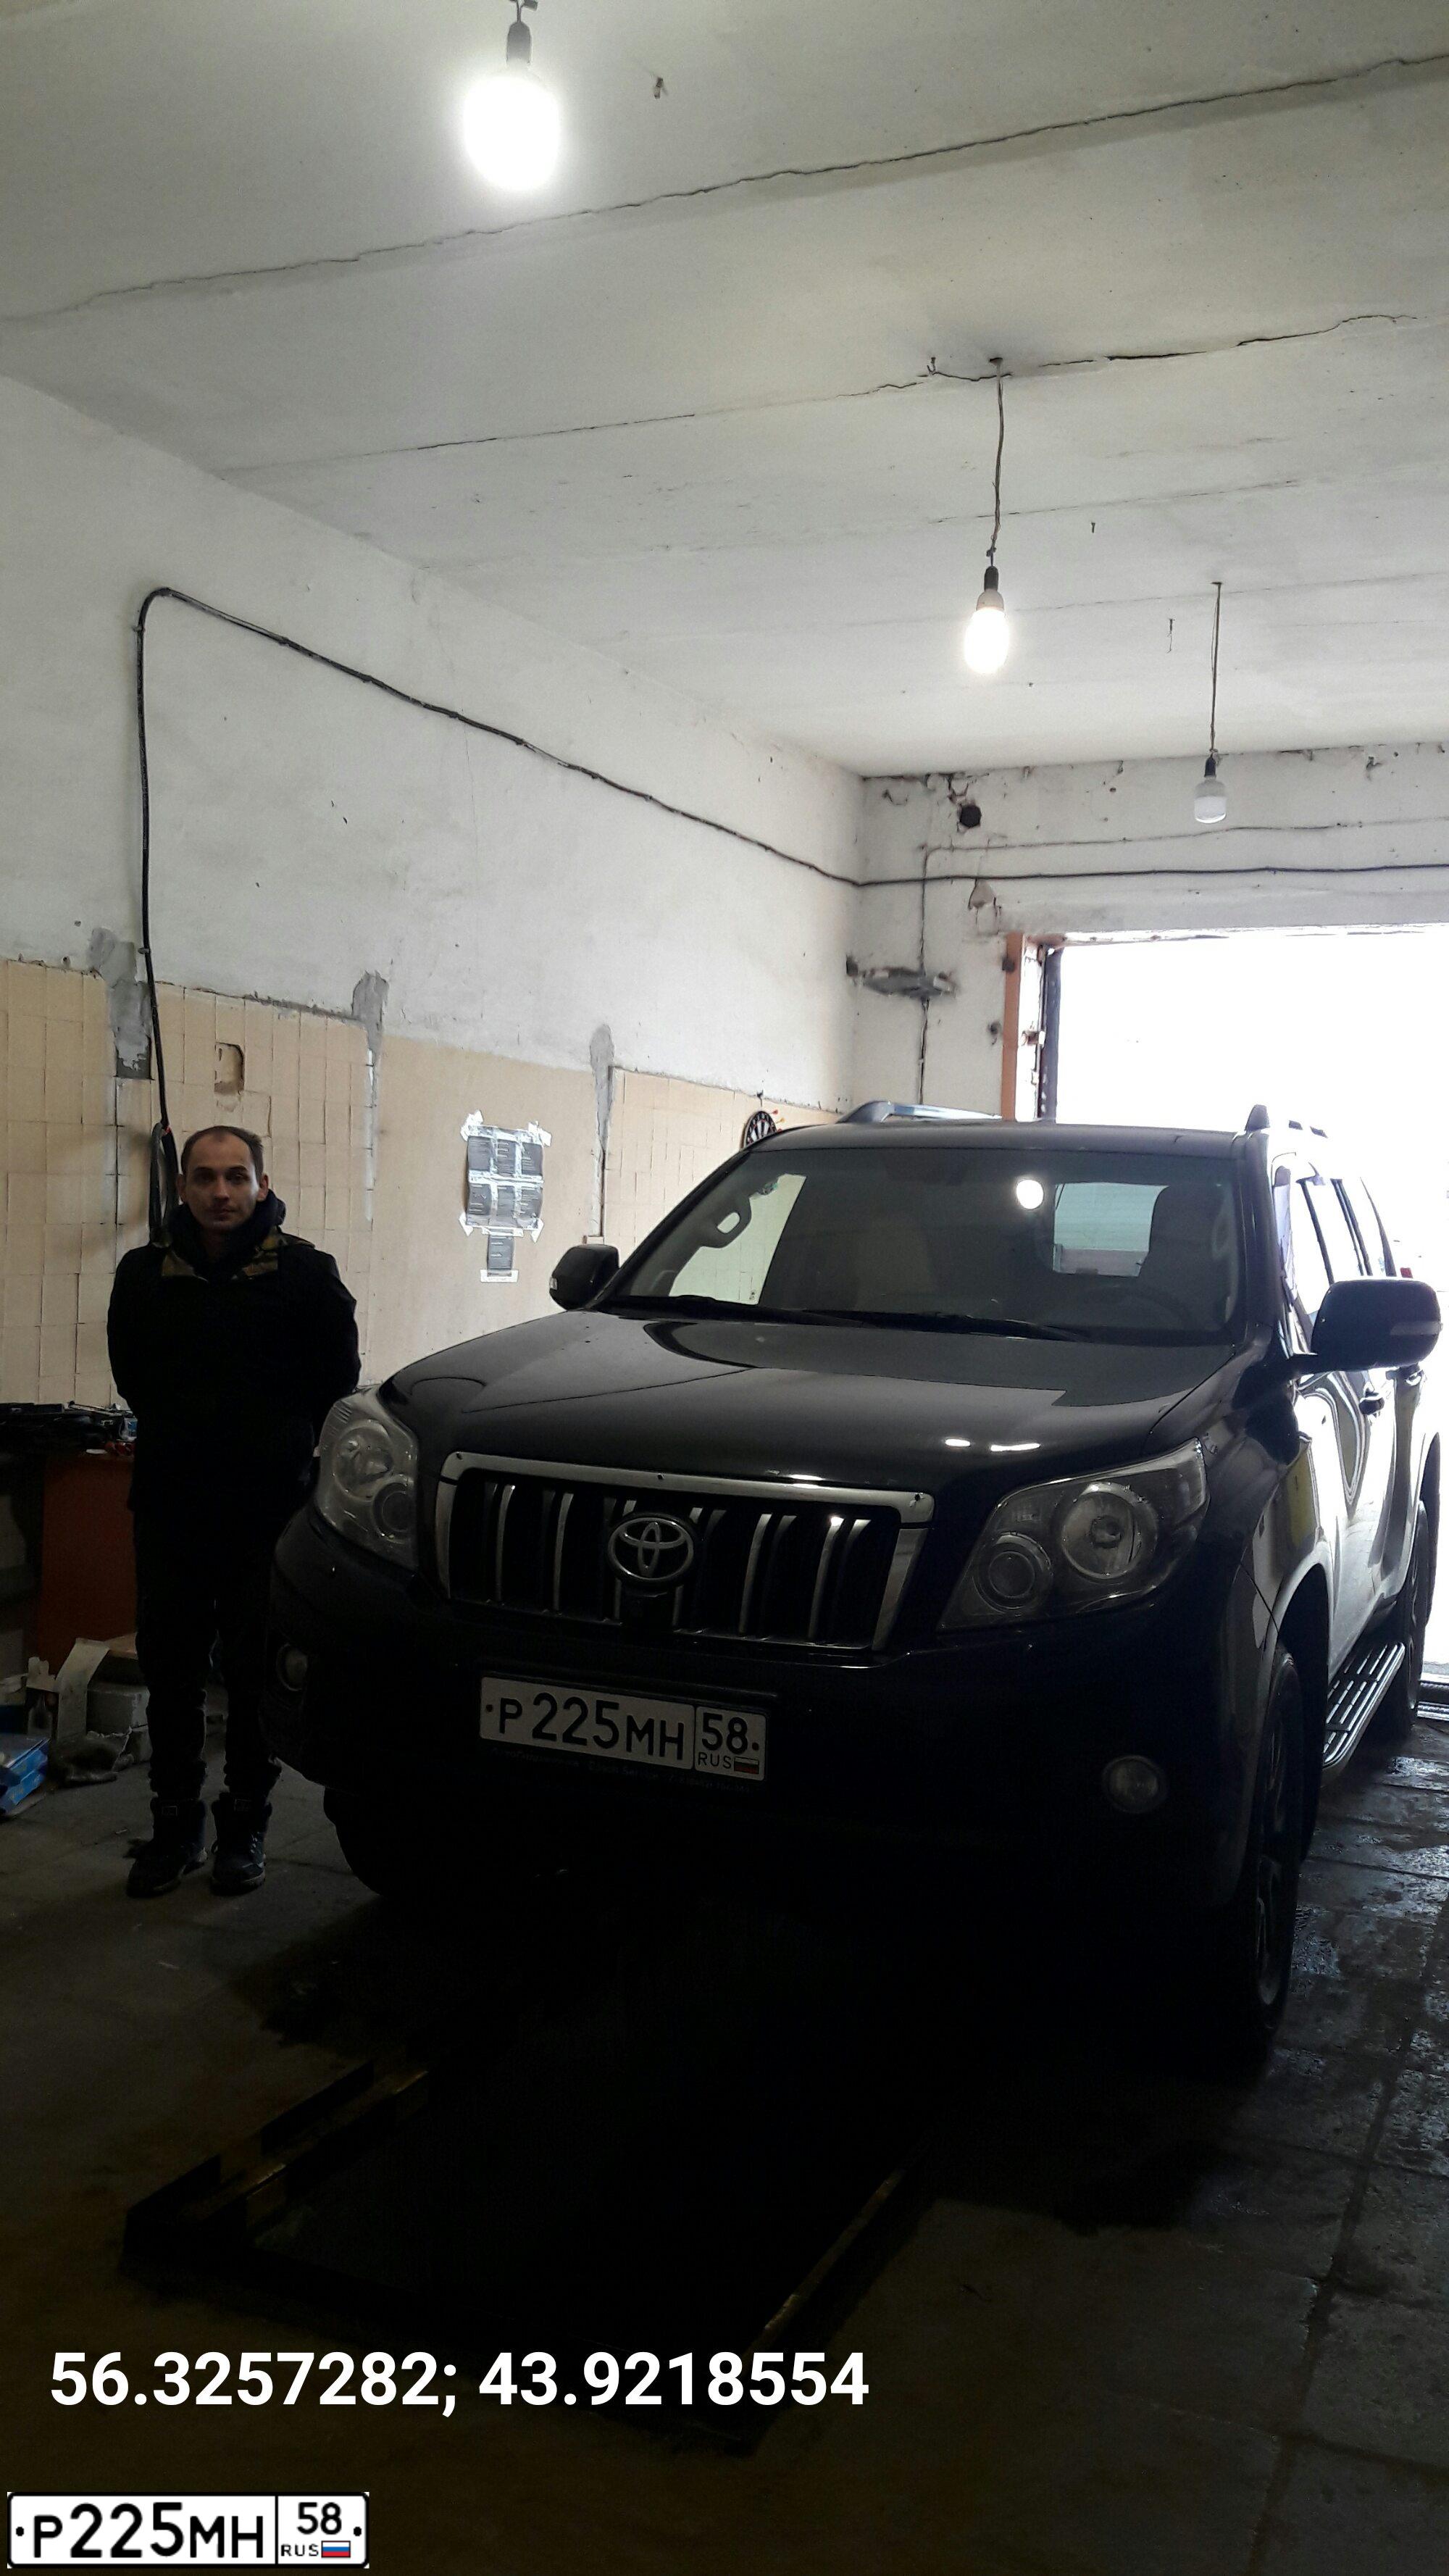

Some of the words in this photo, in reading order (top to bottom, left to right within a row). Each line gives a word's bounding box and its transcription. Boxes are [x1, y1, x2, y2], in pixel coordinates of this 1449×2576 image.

[497, 1692, 685, 1762] Р225МН
[701, 1712, 749, 1756] 58
[697, 1751, 732, 1770] RUS
